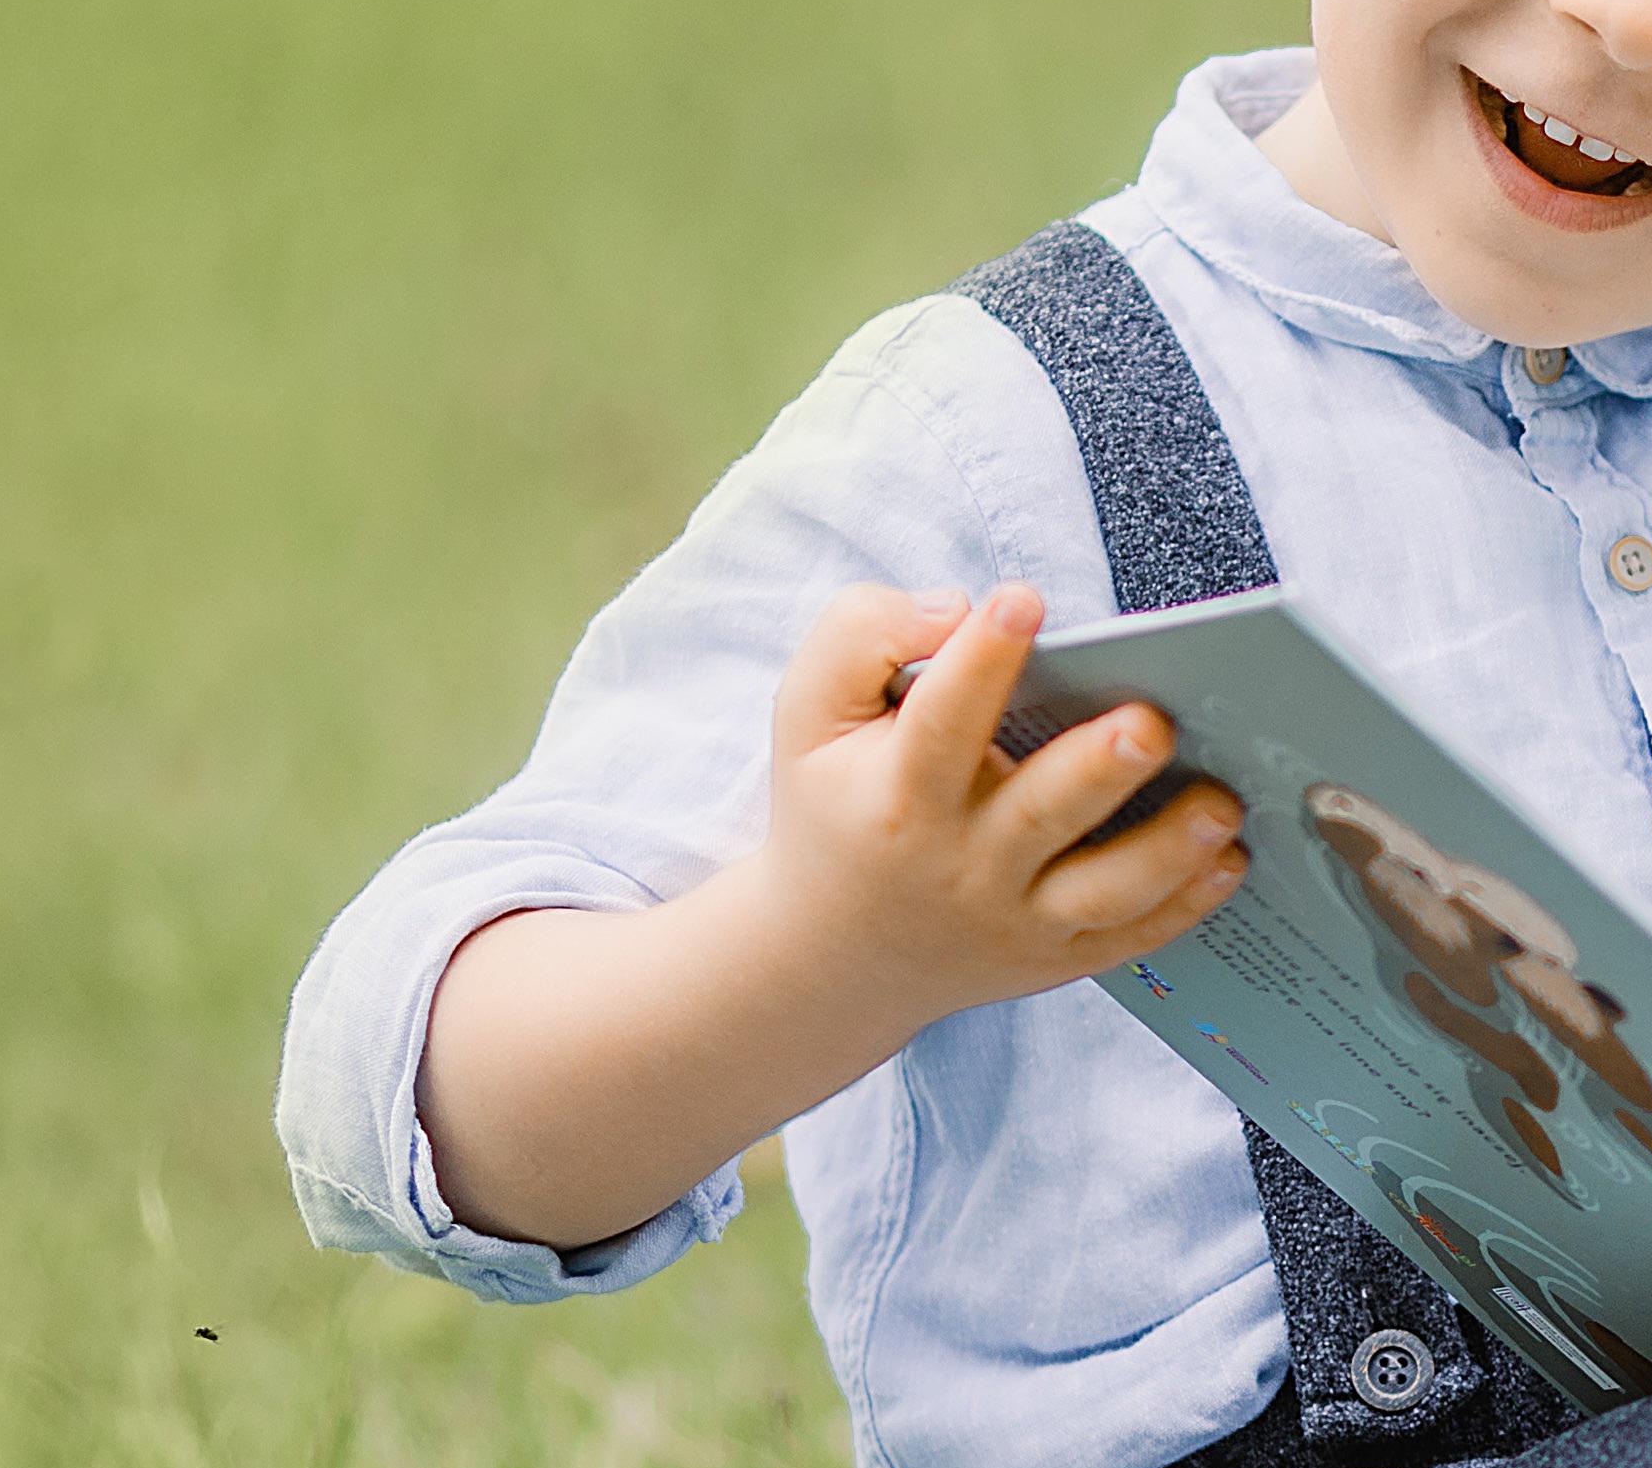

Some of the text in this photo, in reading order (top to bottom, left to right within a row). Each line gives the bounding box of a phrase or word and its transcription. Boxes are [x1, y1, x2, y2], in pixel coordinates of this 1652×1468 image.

[1196, 932, 1271, 994] ludzie?
[1305, 1012, 1334, 1036] ma
[1339, 1042, 1381, 1078] inne
[1384, 1082, 1432, 1119] sny?
[1318, 988, 1421, 1078] zachowuje
[1423, 1082, 1451, 1105] się
[1455, 1109, 1524, 1174] inaczej.
